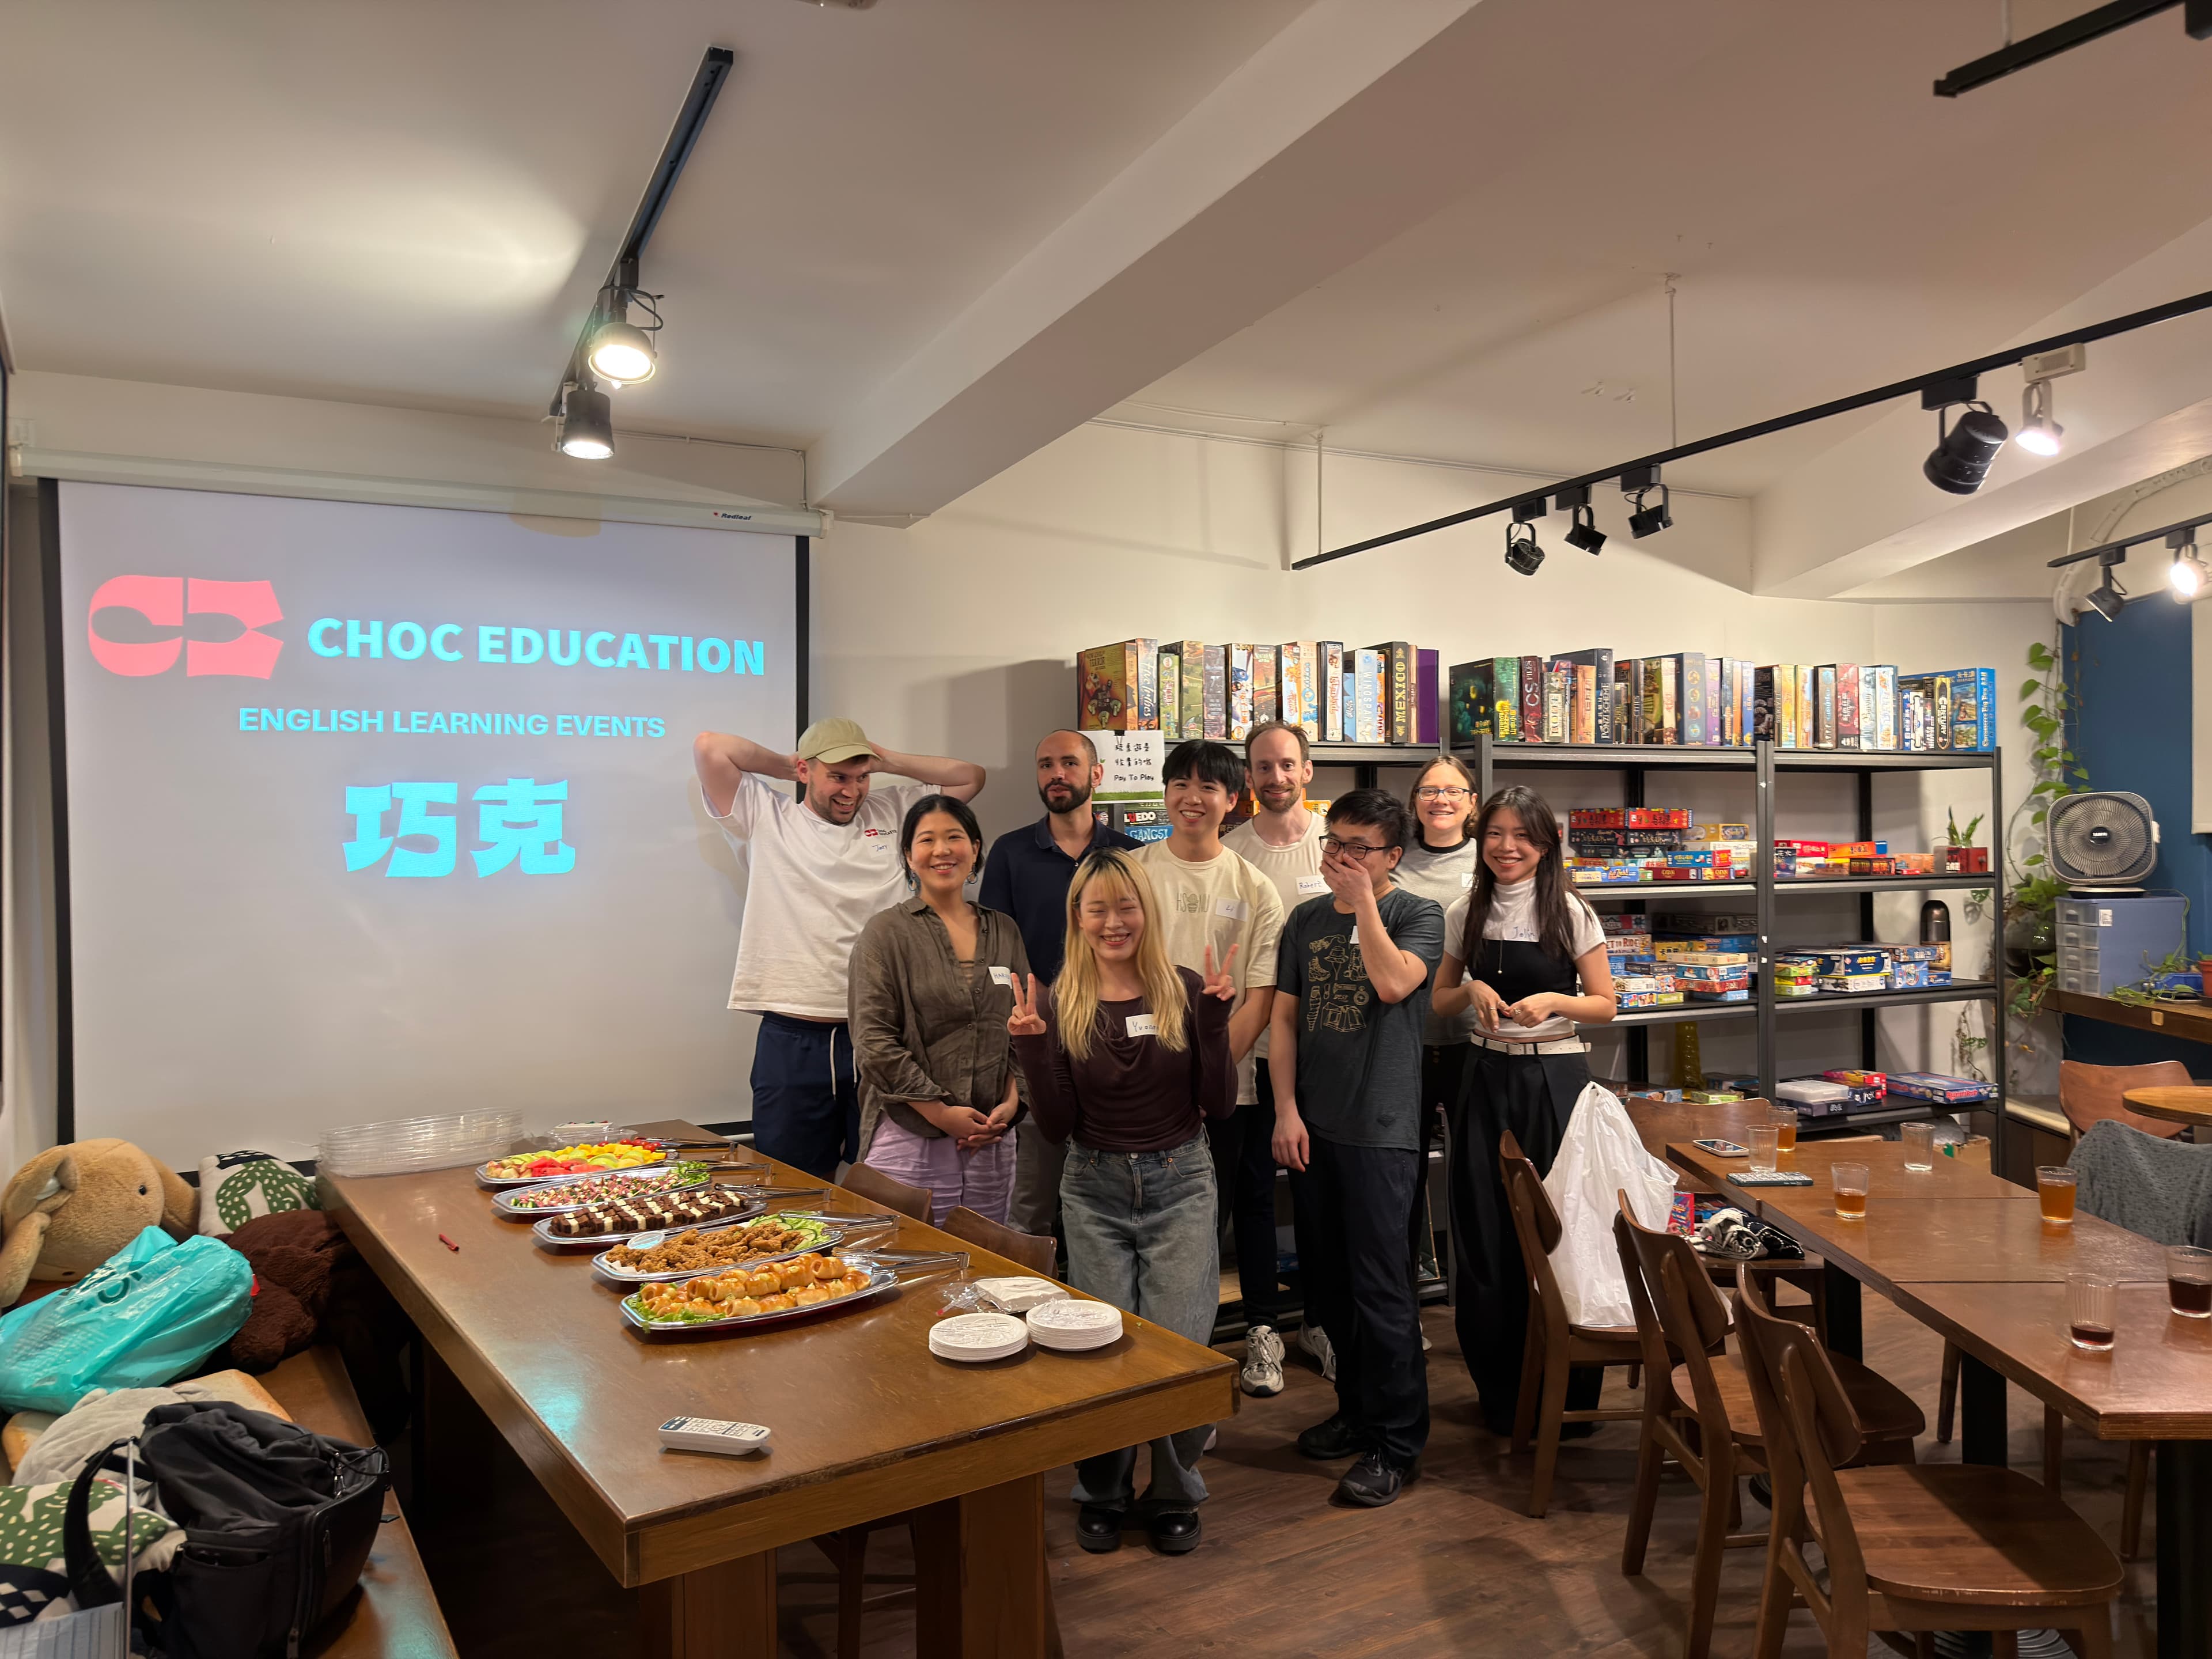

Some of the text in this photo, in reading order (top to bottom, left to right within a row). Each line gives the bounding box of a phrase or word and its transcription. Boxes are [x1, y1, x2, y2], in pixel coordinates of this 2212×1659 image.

[306, 617, 765, 677] CHOC EDUCATION
[1525, 682, 1540, 707] CS
[1601, 683, 1610, 713] SCHEME
[238, 708, 666, 738] ENGLISH LEARNING EVENTS
[1601, 715, 1610, 739] PONZI
[343, 778, 576, 878] 巧克
